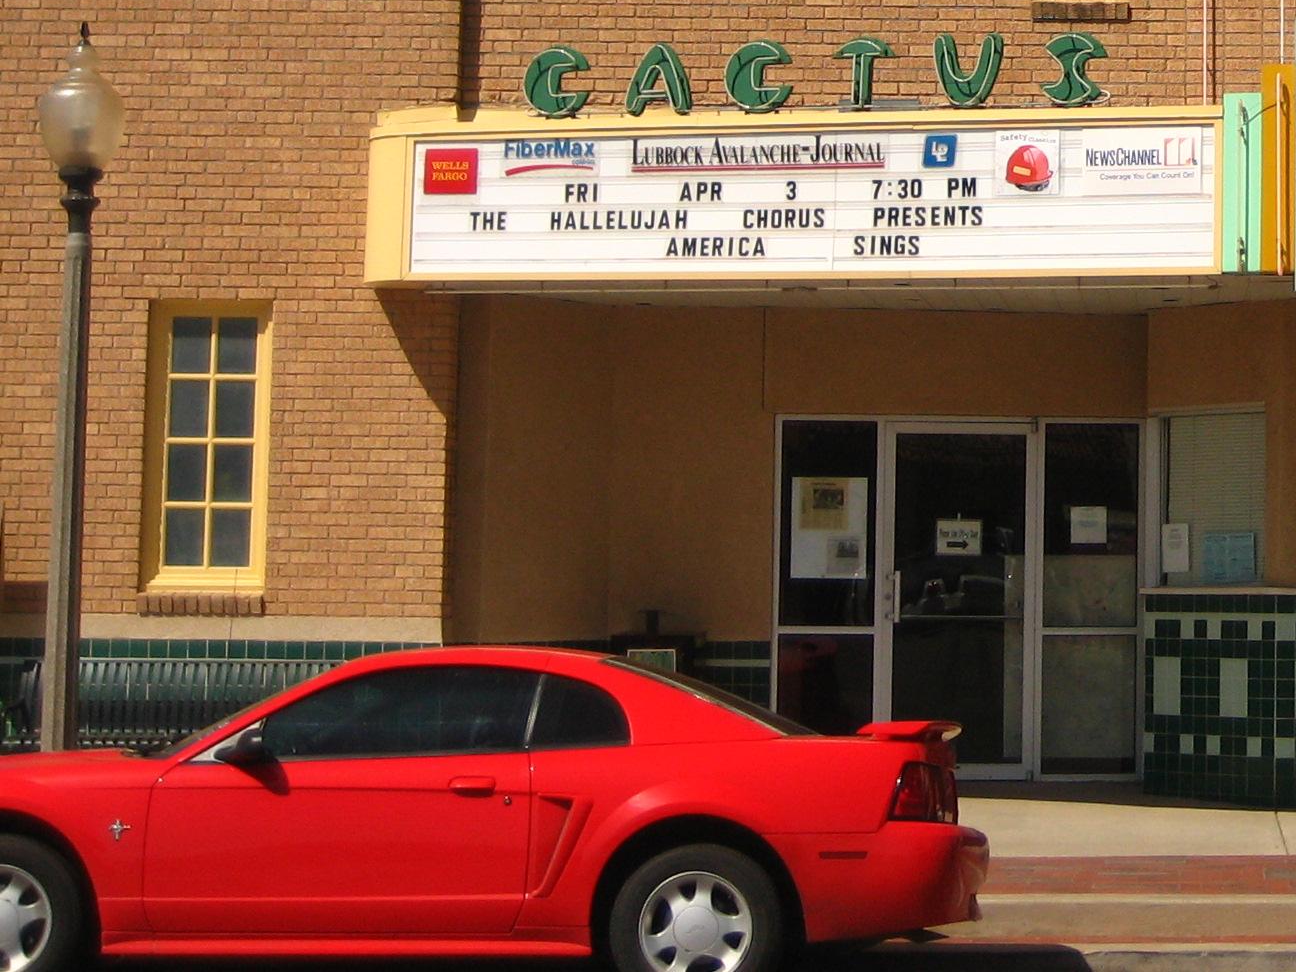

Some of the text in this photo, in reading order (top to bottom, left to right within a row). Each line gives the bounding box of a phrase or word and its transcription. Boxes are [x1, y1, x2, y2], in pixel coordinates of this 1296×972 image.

[522, 32, 1111, 119] CACTUS
[1000, 133, 1028, 142] Safety
[503, 139, 595, 158] FiberMax
[631, 139, 702, 167] LUBBOCK
[432, 161, 469, 170] WELLS
[431, 172, 468, 181] FARGO
[1099, 173, 1131, 181] Coverage
[1133, 172, 1145, 180] You
[1146, 172, 1159, 180] Can
[565, 177, 977, 203] FRI APR 3 7:30 PM
[470, 206, 983, 231] THE HALLELUJAH CHORUS PRESENTS
[666, 235, 920, 257] AMERICA SINGS
